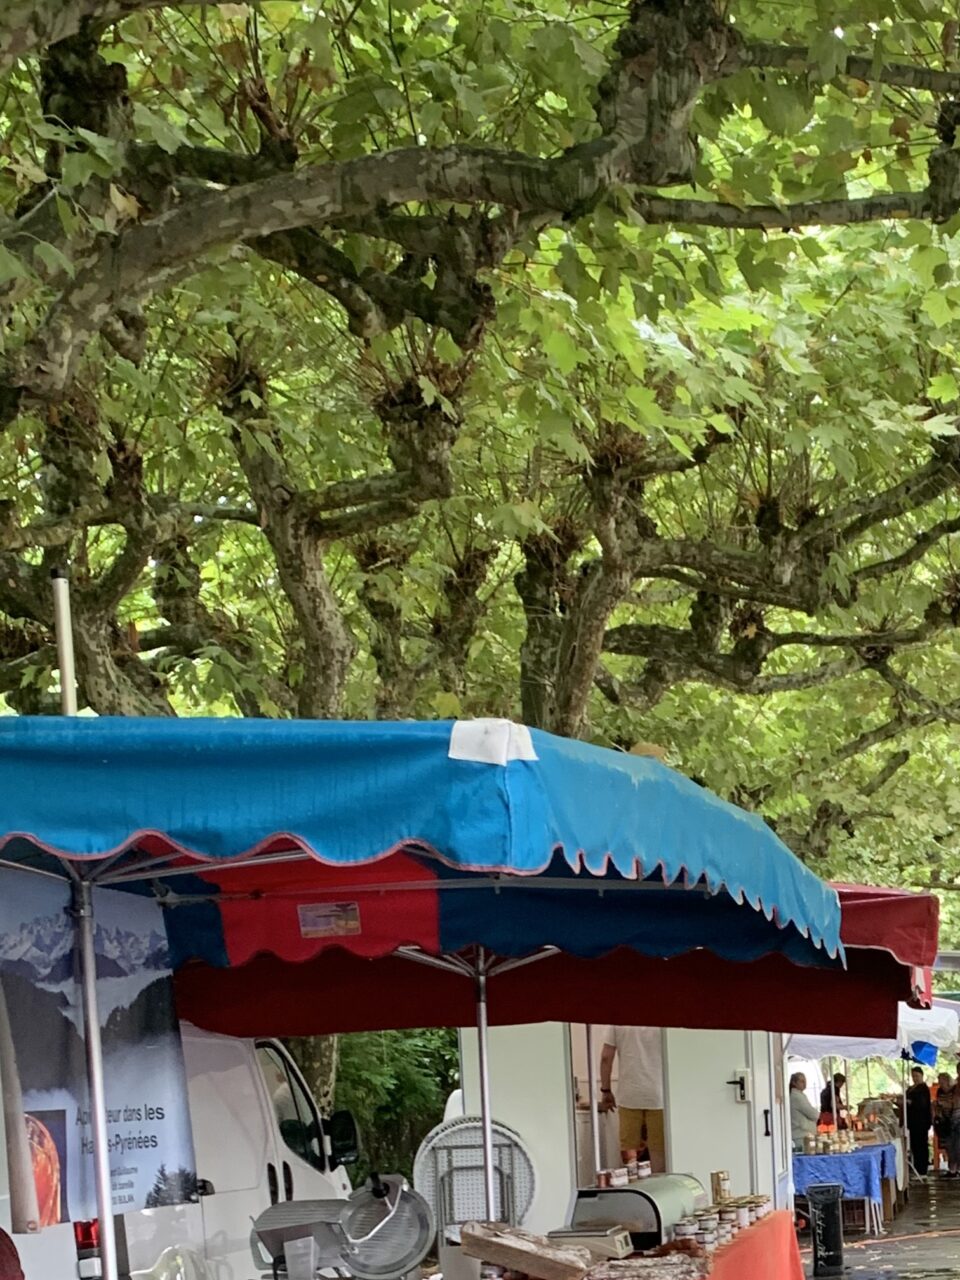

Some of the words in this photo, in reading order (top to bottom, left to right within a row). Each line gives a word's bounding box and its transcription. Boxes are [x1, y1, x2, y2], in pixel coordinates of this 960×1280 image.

[123, 1104, 142, 1122] dans
[144, 1103, 165, 1120] les
[81, 1130, 158, 1155] Has-Pyrénées
